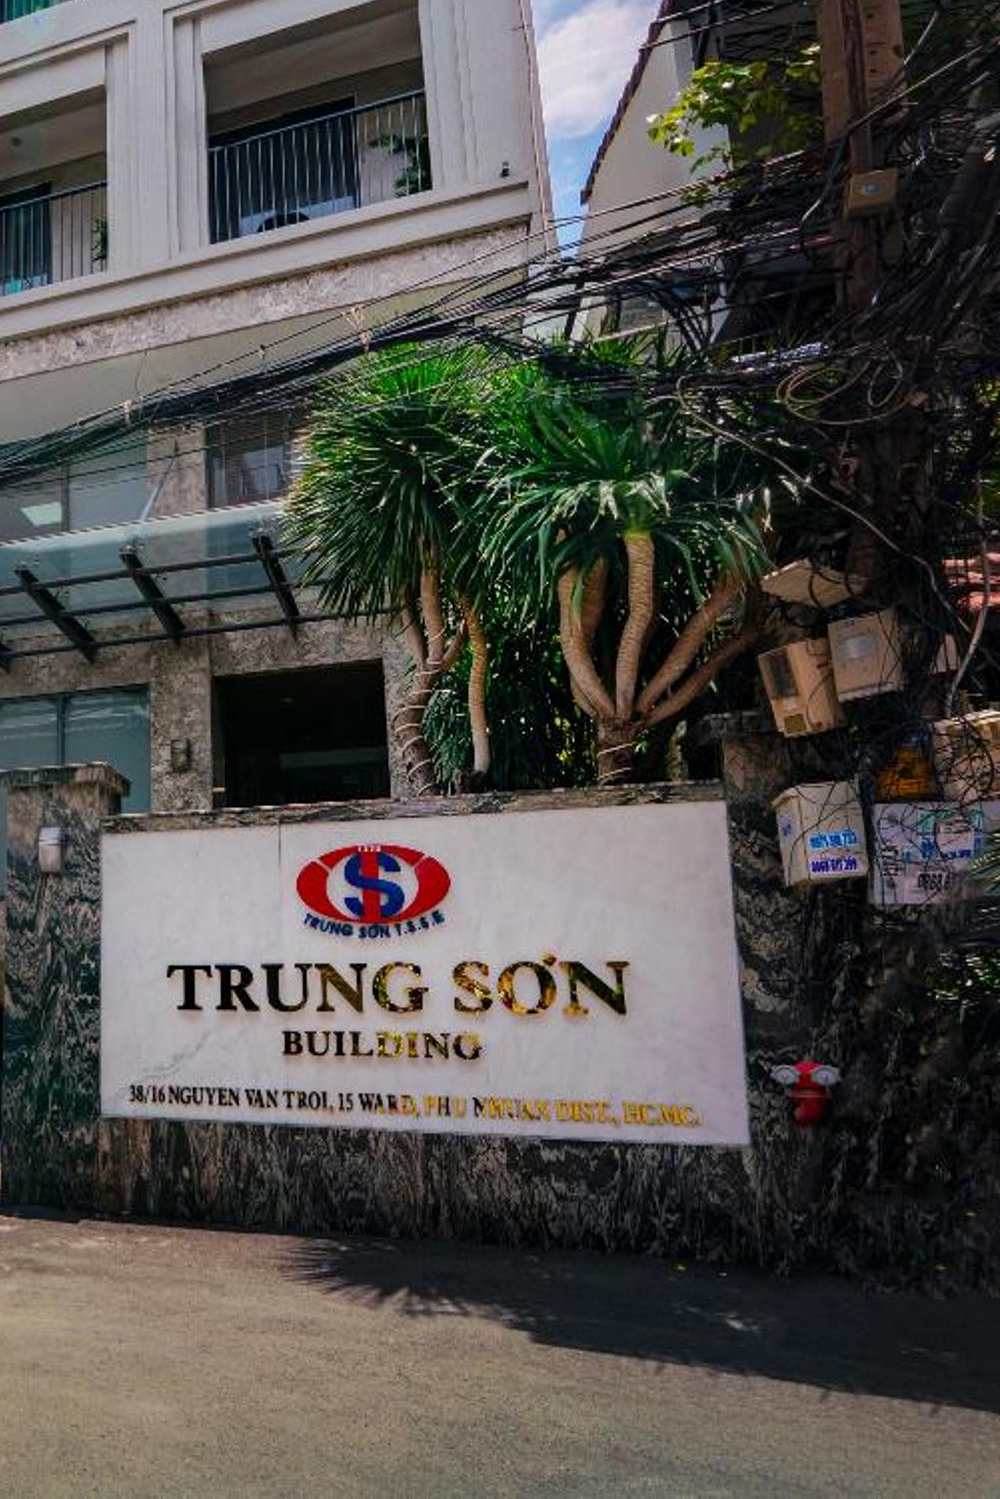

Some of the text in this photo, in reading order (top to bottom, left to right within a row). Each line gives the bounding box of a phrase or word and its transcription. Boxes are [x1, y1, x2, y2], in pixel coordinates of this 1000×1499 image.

[303, 913, 353, 936] TRUNG
[166, 953, 631, 1017] TRUNG SƠN
[282, 1030, 485, 1061] BUILDING
[168, 1086, 240, 1107] NGUYEN
[244, 1088, 278, 1109] VAN
[338, 1093, 354, 1112] 15
[423, 1095, 467, 1118] PHU
[472, 1096, 551, 1121] NHUAN
